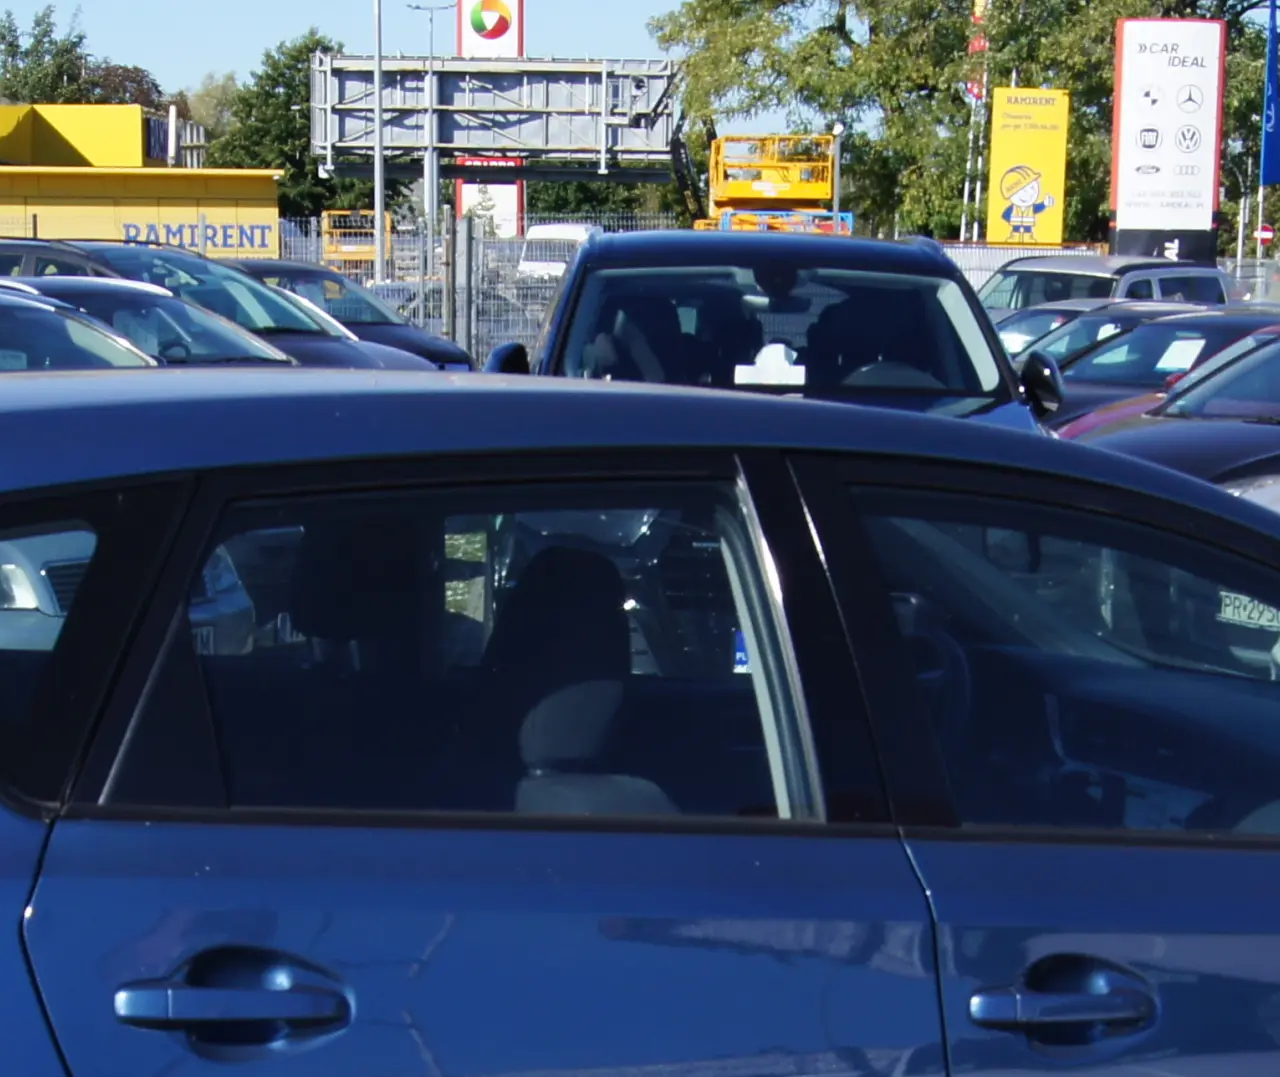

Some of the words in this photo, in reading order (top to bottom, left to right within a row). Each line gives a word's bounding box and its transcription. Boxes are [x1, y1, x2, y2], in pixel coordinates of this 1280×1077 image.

[1149, 42, 1180, 54] CAR
[1167, 55, 1208, 68] IDEAL
[122, 223, 272, 249] RAMIRENT
